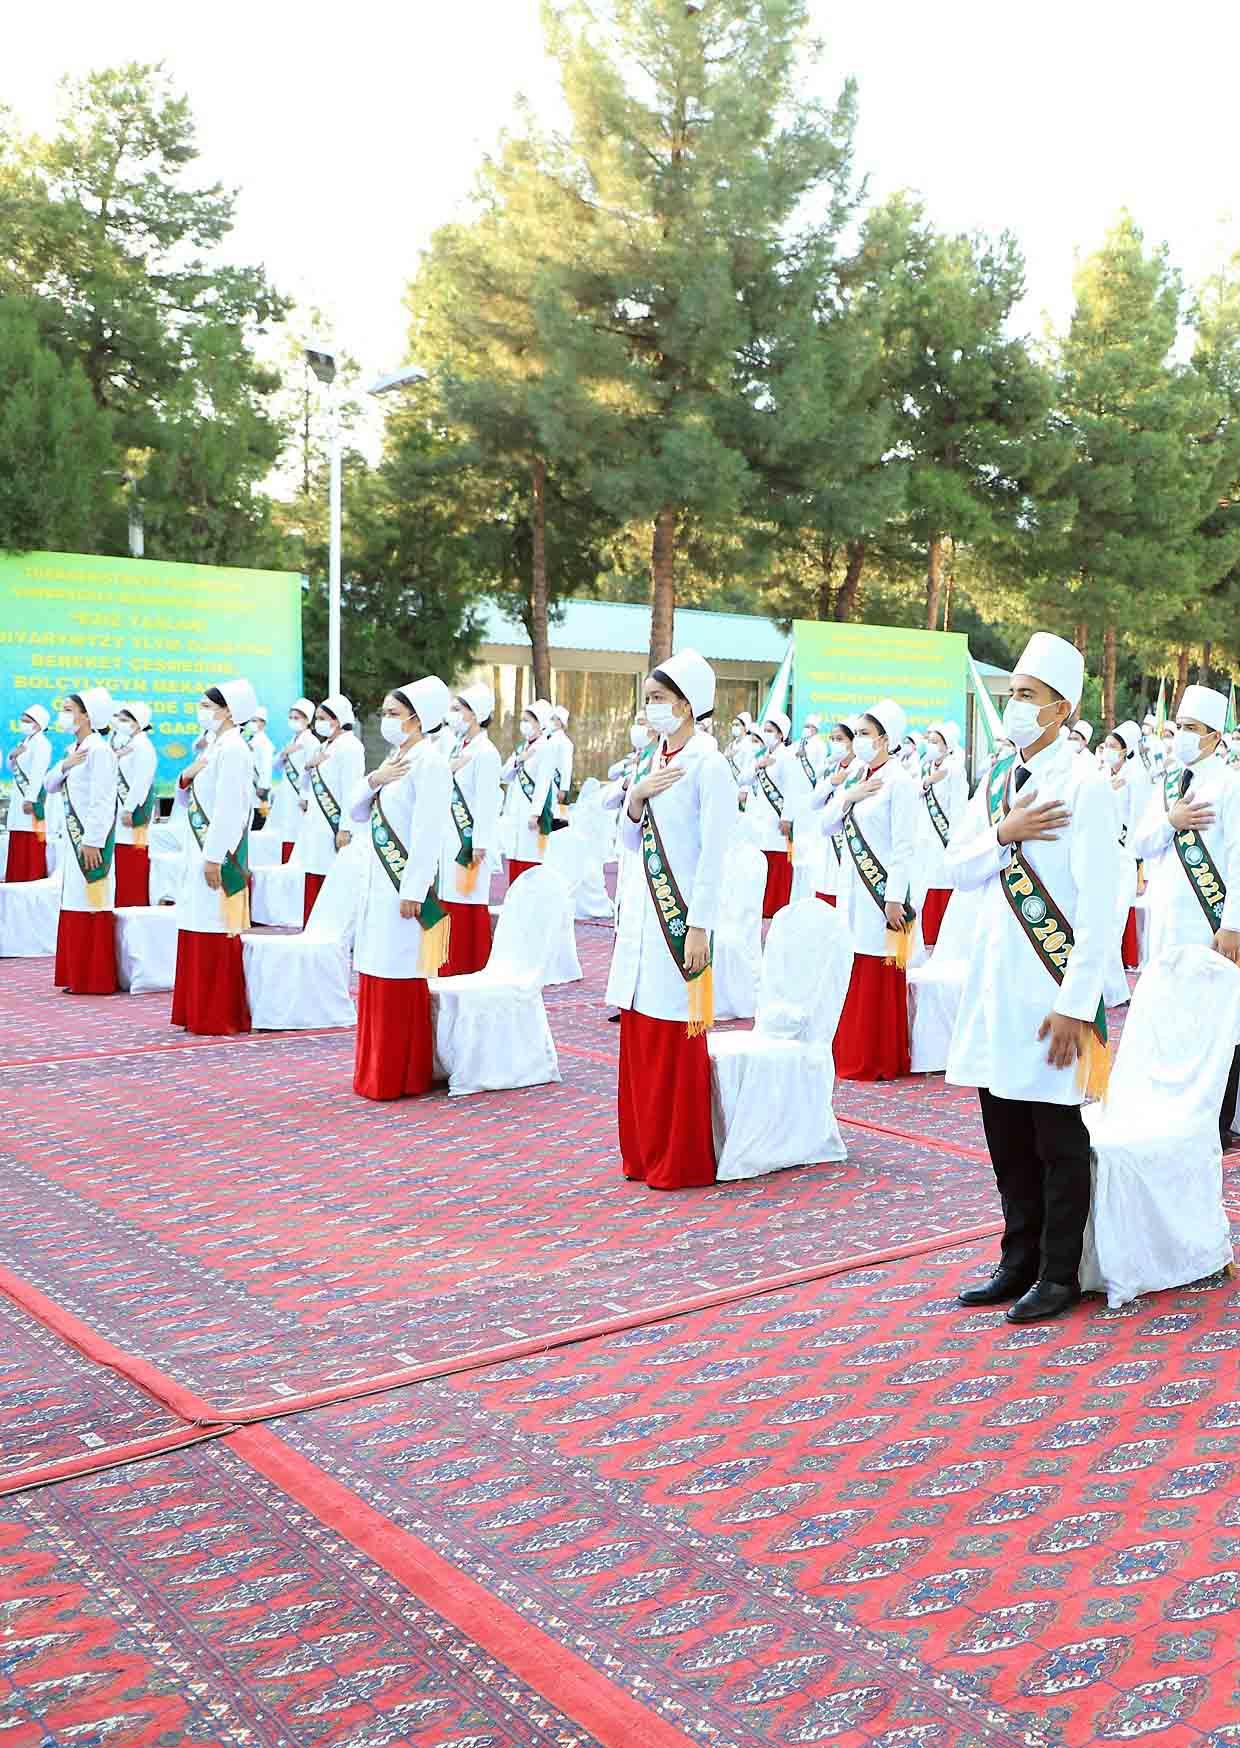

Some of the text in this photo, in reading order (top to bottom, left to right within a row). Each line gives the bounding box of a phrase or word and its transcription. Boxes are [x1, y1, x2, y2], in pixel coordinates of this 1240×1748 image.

[855, 851, 884, 887] 2021
[1191, 863, 1225, 906] 2021
[651, 873, 681, 923] 2021
